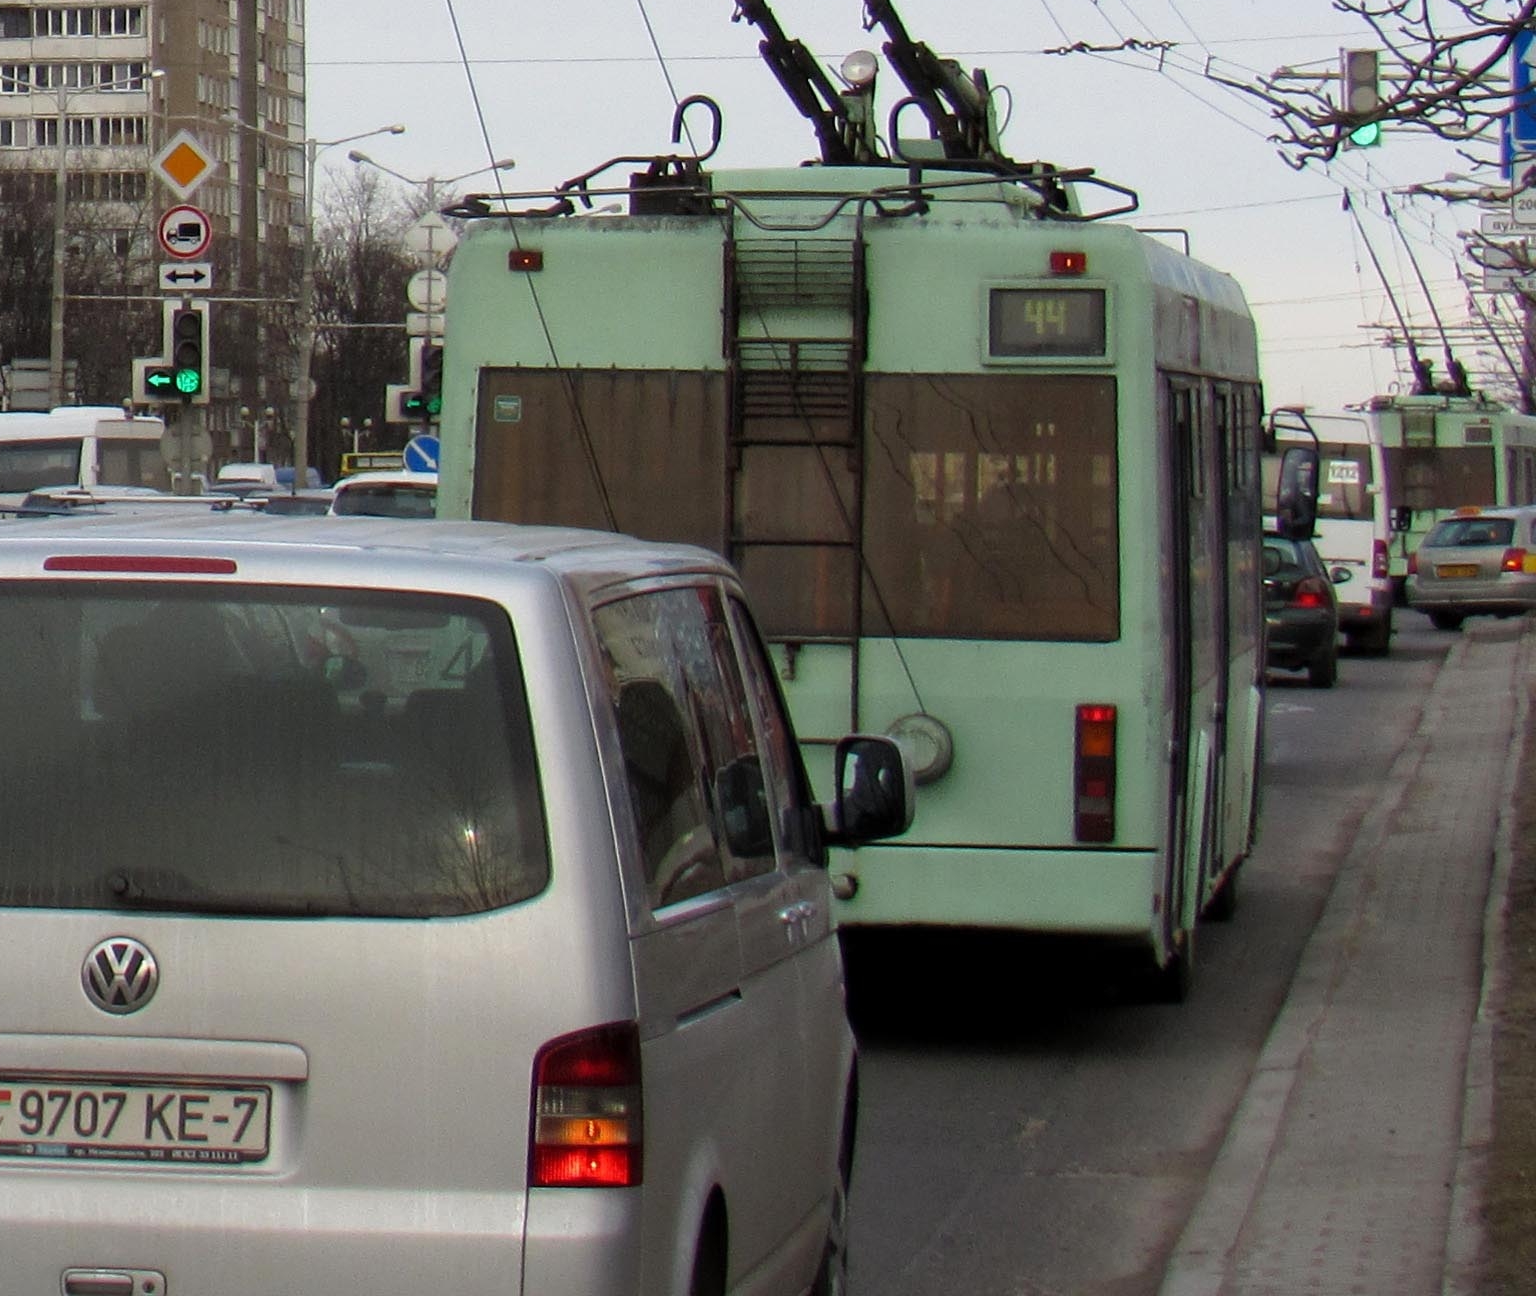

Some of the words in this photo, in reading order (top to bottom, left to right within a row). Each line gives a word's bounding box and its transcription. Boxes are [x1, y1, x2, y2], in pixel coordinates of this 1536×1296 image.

[1023, 298, 1068, 336] 44
[18, 1089, 128, 1138] 9707
[144, 1092, 259, 1143] KE-7
